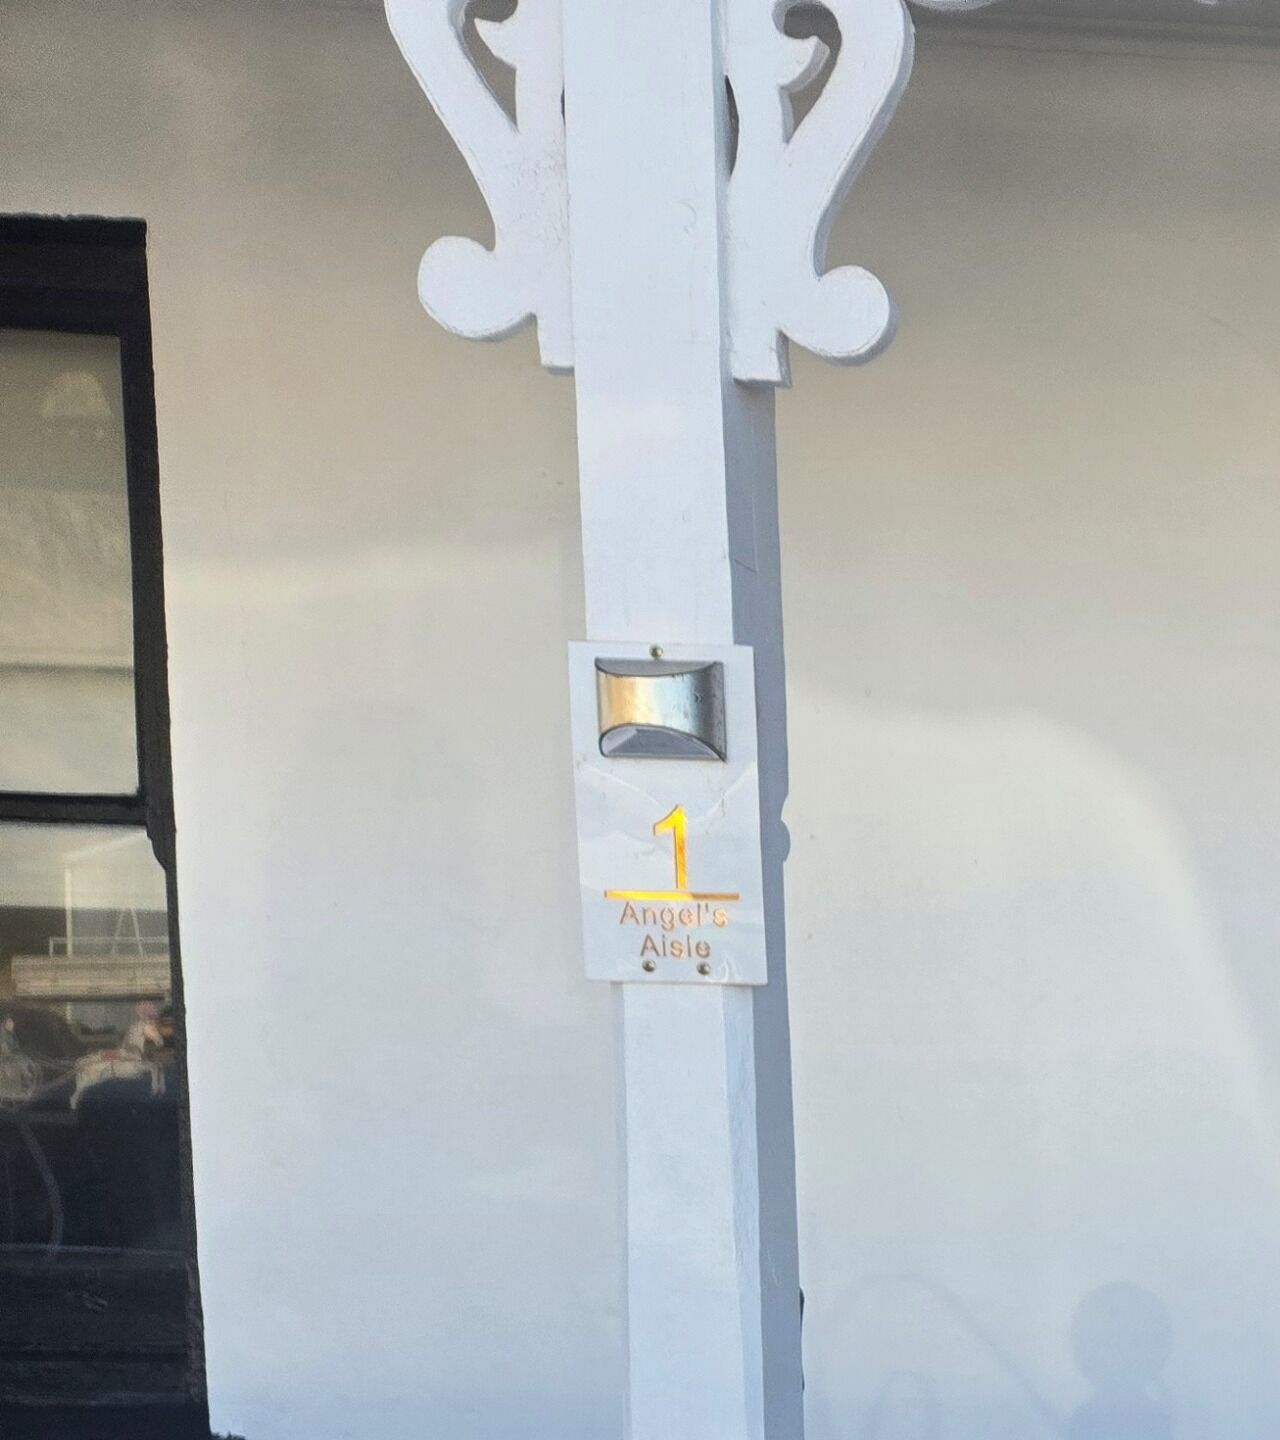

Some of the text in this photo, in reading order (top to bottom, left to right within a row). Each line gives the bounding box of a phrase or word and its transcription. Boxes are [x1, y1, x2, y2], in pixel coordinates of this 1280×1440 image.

[653, 804, 688, 889] 1
[619, 901, 729, 931] Angel's
[640, 933, 711, 959] Aisle
